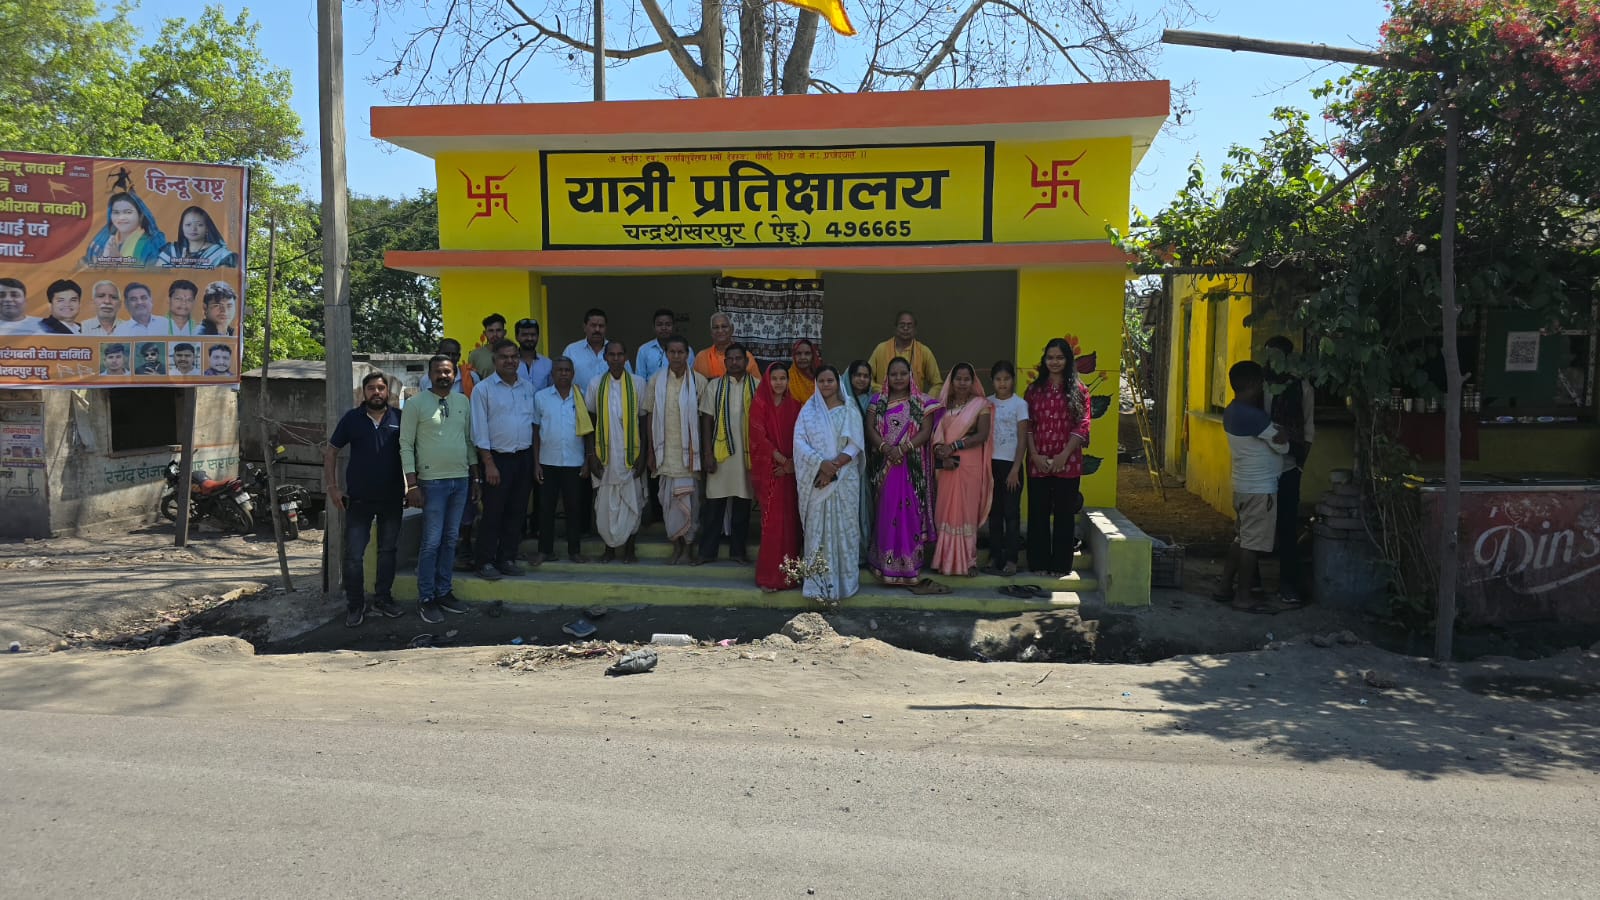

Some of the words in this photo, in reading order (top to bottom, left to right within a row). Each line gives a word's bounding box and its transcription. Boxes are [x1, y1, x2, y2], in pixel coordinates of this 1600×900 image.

[24, 162, 66, 176] नववर्ष
[146, 168, 191, 200] हिन्दू
[191, 177, 225, 201] राष्ट्र
[565, 161, 676, 216] यात्री
[690, 160, 950, 218] प्रतिक्षालय
[26, 220, 50, 237] एवं
[622, 215, 746, 245] चन्द्रशेखरपुर
[825, 220, 912, 238] 496665
[38, 347, 57, 360] सेवा
[59, 348, 92, 360] समिति
